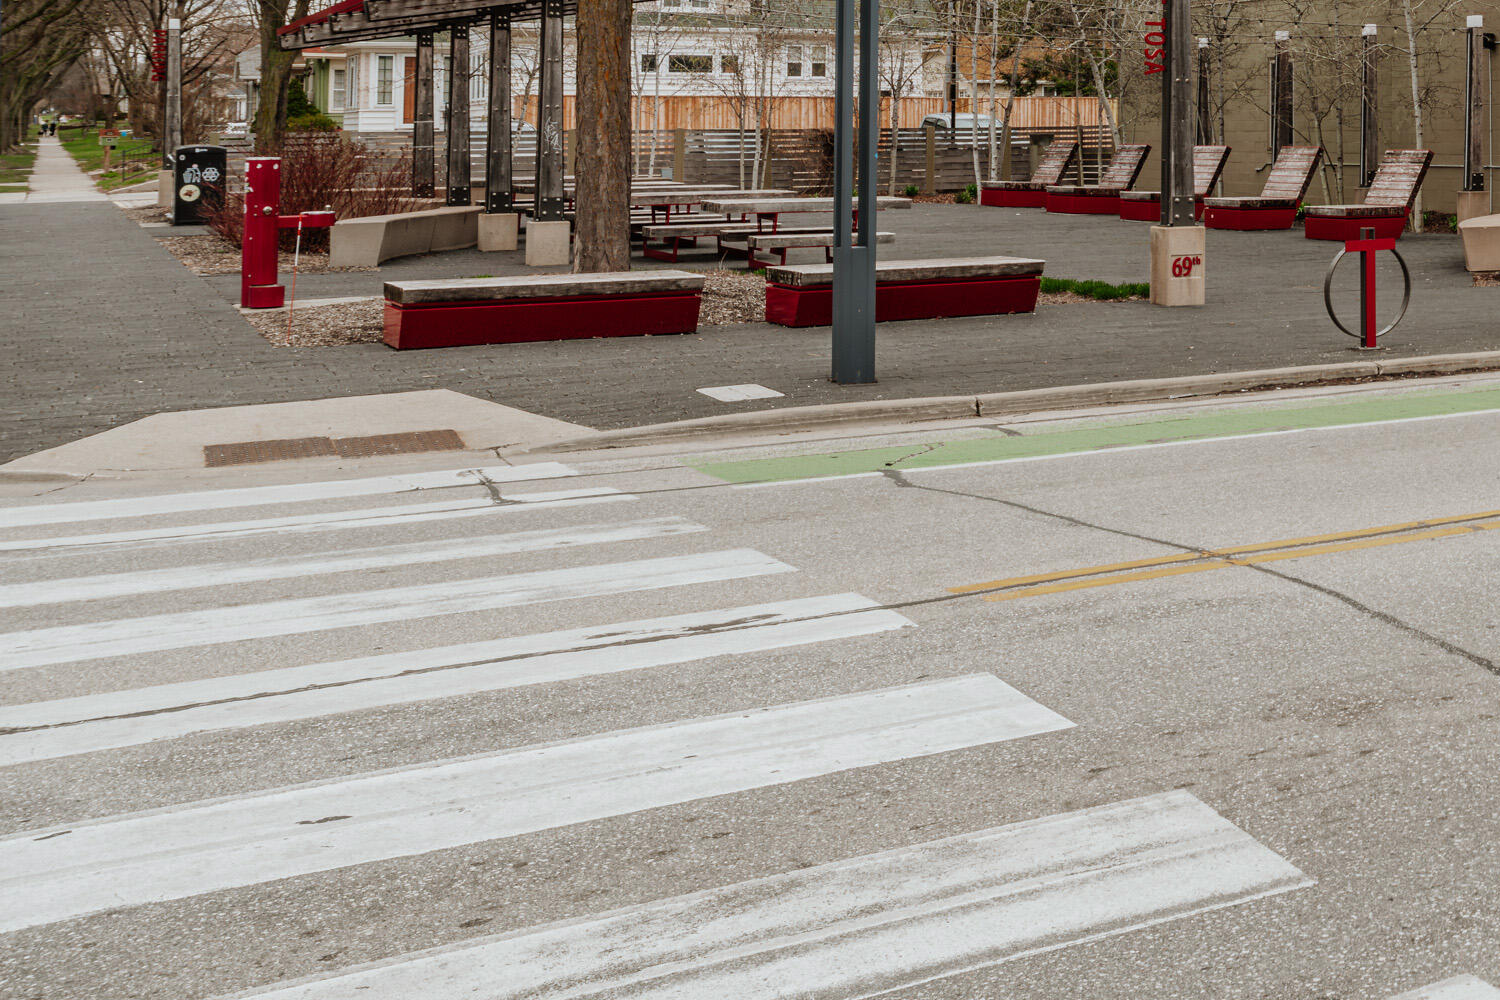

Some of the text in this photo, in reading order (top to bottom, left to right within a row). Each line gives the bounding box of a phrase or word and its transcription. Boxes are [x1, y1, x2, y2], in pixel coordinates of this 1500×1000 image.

[152, 30, 167, 82] PARKING
[1144, 18, 1166, 75] TOSA
[1172, 255, 1201, 278] 69th
[1345, 238, 1396, 348] T
